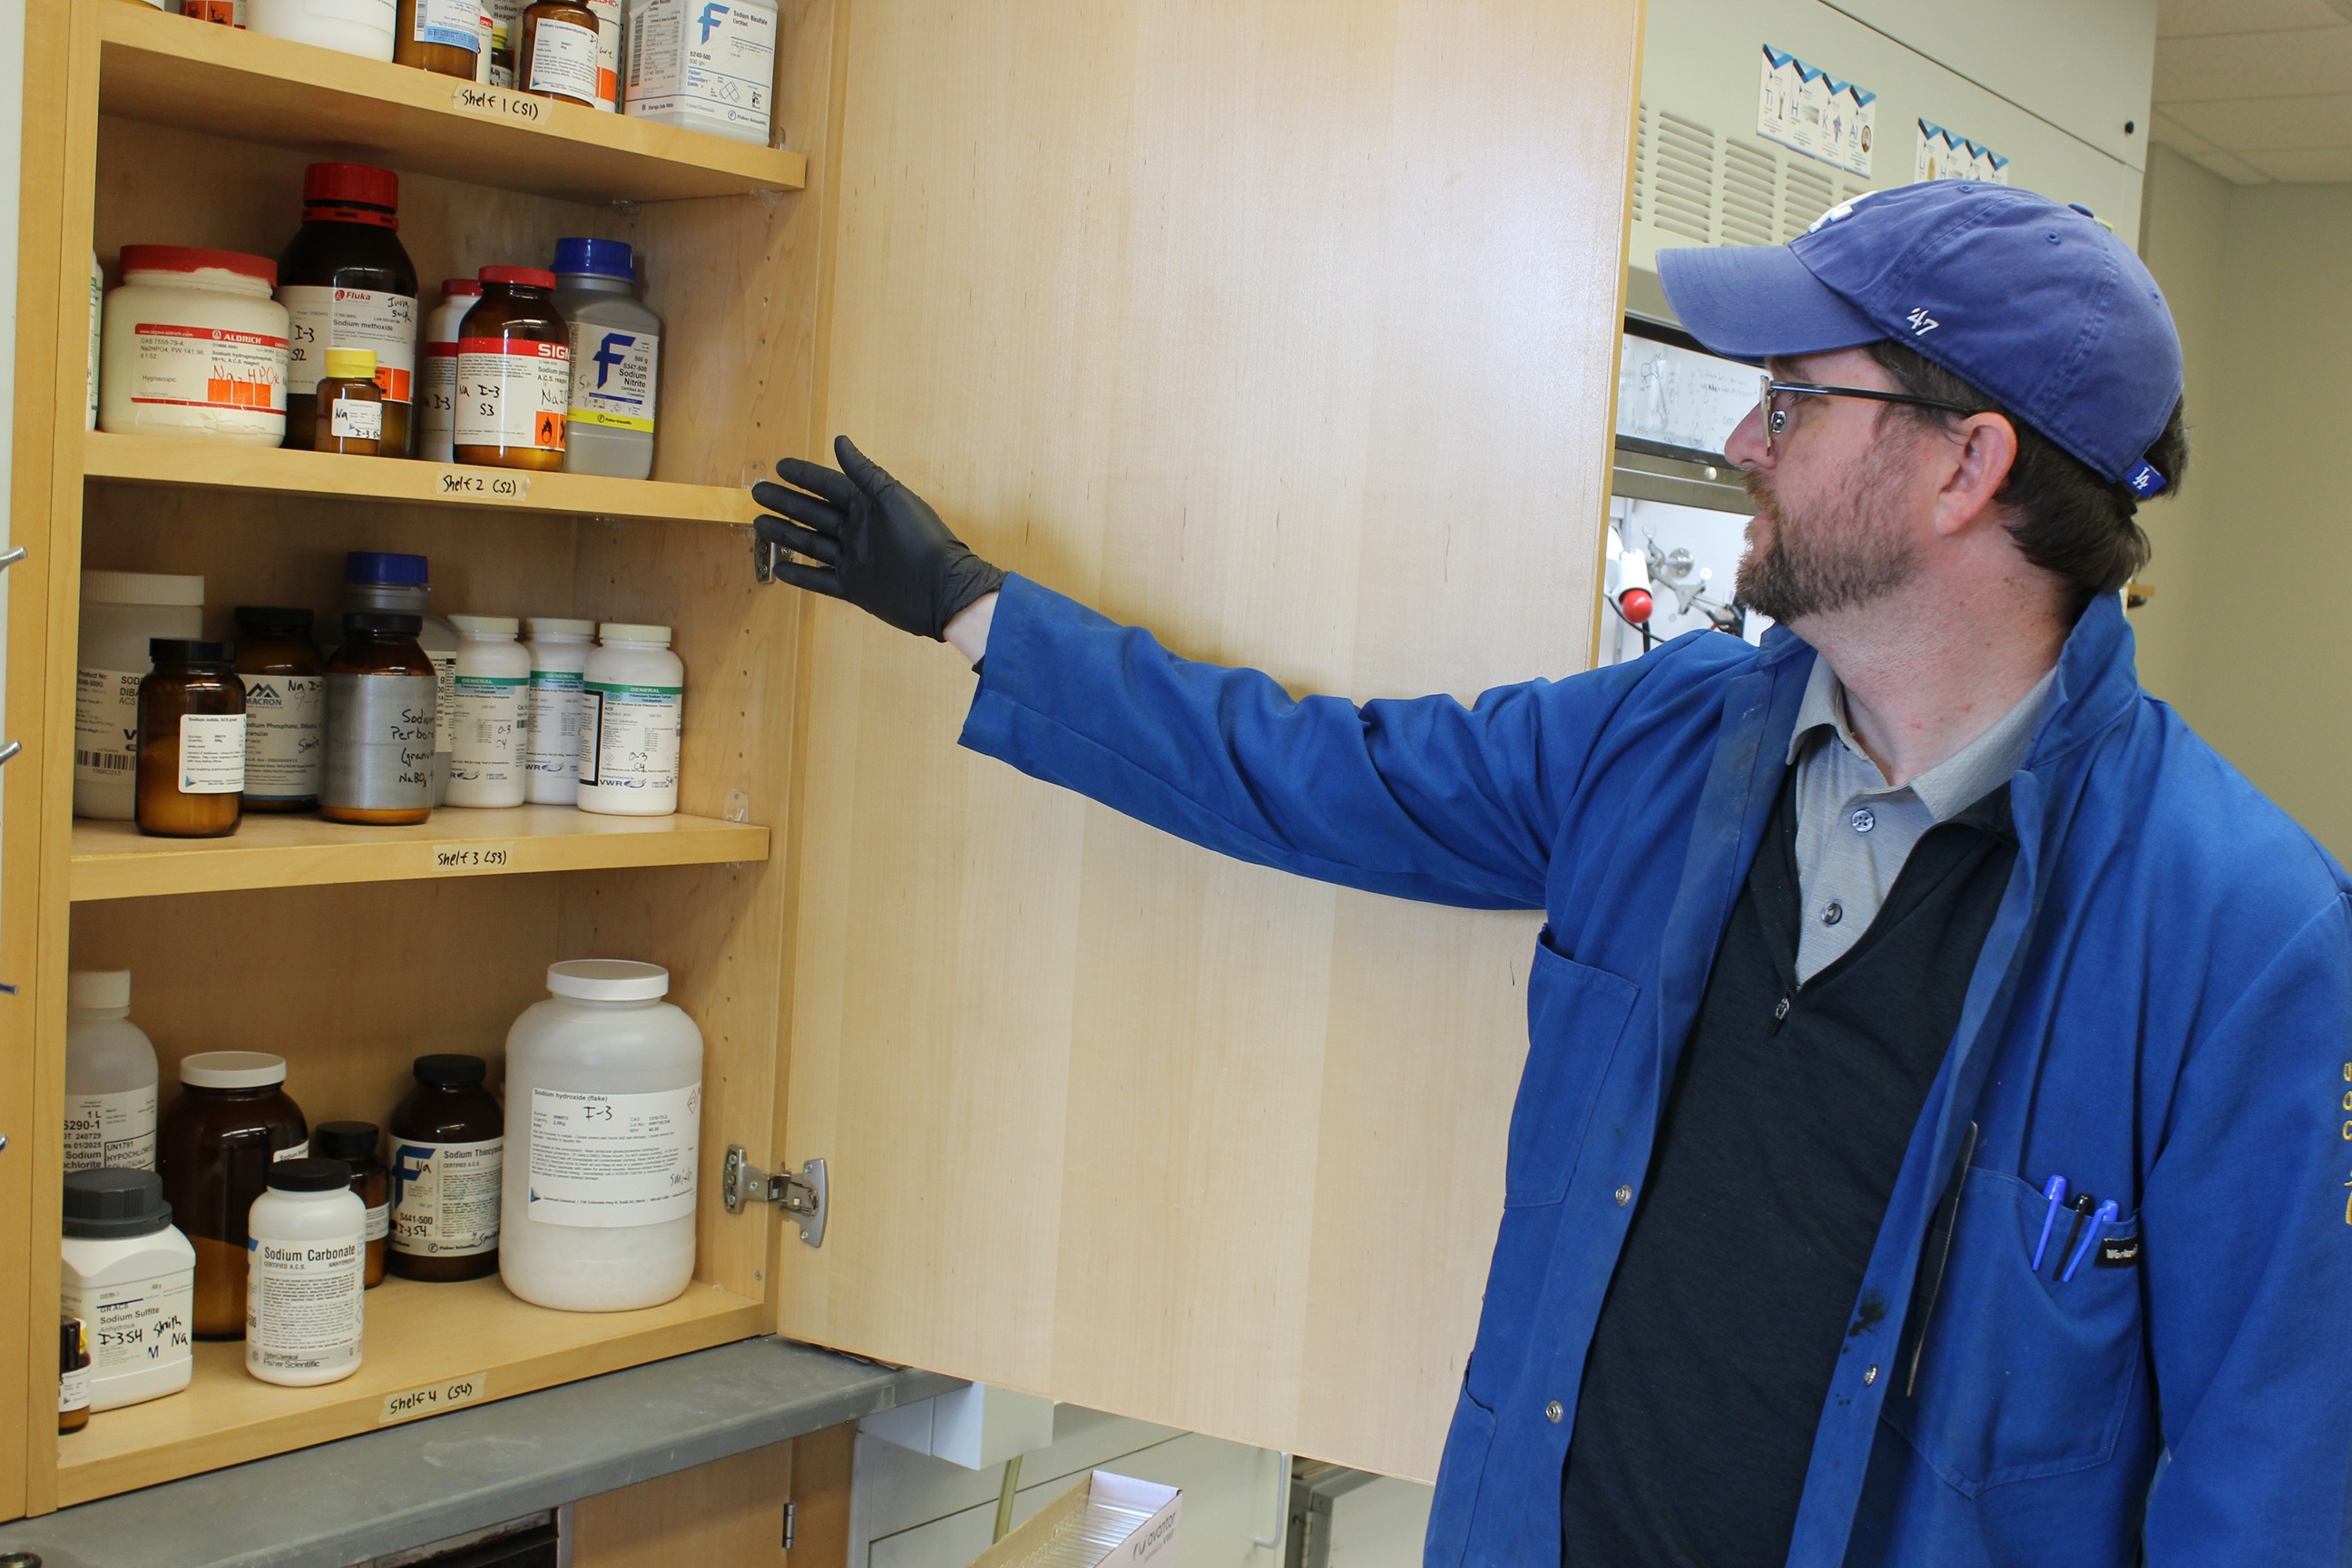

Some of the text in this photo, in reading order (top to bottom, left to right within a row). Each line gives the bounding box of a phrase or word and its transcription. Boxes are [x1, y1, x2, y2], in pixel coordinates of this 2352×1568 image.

[733, 10, 750, 20] Sodium
[462, 90, 538, 121] Shelf 1 (S1)
[1791, 99, 1798, 116] H
[1823, 114, 1828, 130] K
[347, 291, 372, 300] Fluka
[361, 322, 394, 331] methoxide
[224, 334, 261, 344] ALDRICH
[291, 348, 307, 361] S2
[619, 368, 647, 379] Sodium
[624, 377, 646, 387] Nitrite
[479, 403, 495, 416] S3
[2132, 467, 2150, 490] LA
[443, 475, 516, 496] Shelf 2 (S2)
[119, 697, 136, 706] ACS
[437, 850, 507, 866] Shelf 3 (S3)
[534, 1089, 554, 1097] Sodium
[555, 1093, 585, 1101] hydroxide
[583, 1105, 612, 1121] I-3
[107, 1141, 133, 1152] UN1791
[444, 1151, 473, 1160] Sodium
[399, 1212, 433, 1225] S441-500
[264, 1245, 356, 1261] Sodium Carbonate
[264, 1261, 288, 1269] CERTIFIED
[328, 1257, 355, 1268] ANHYDROUS
[100, 1308, 160, 1325] Sodium Sulfite
[101, 1323, 135, 1333] Anhydrous
[285, 1360, 319, 1368] Scientific
[390, 1383, 472, 1415] Shelf 4 (S4)
[1148, 1510, 1178, 1545] avantor
